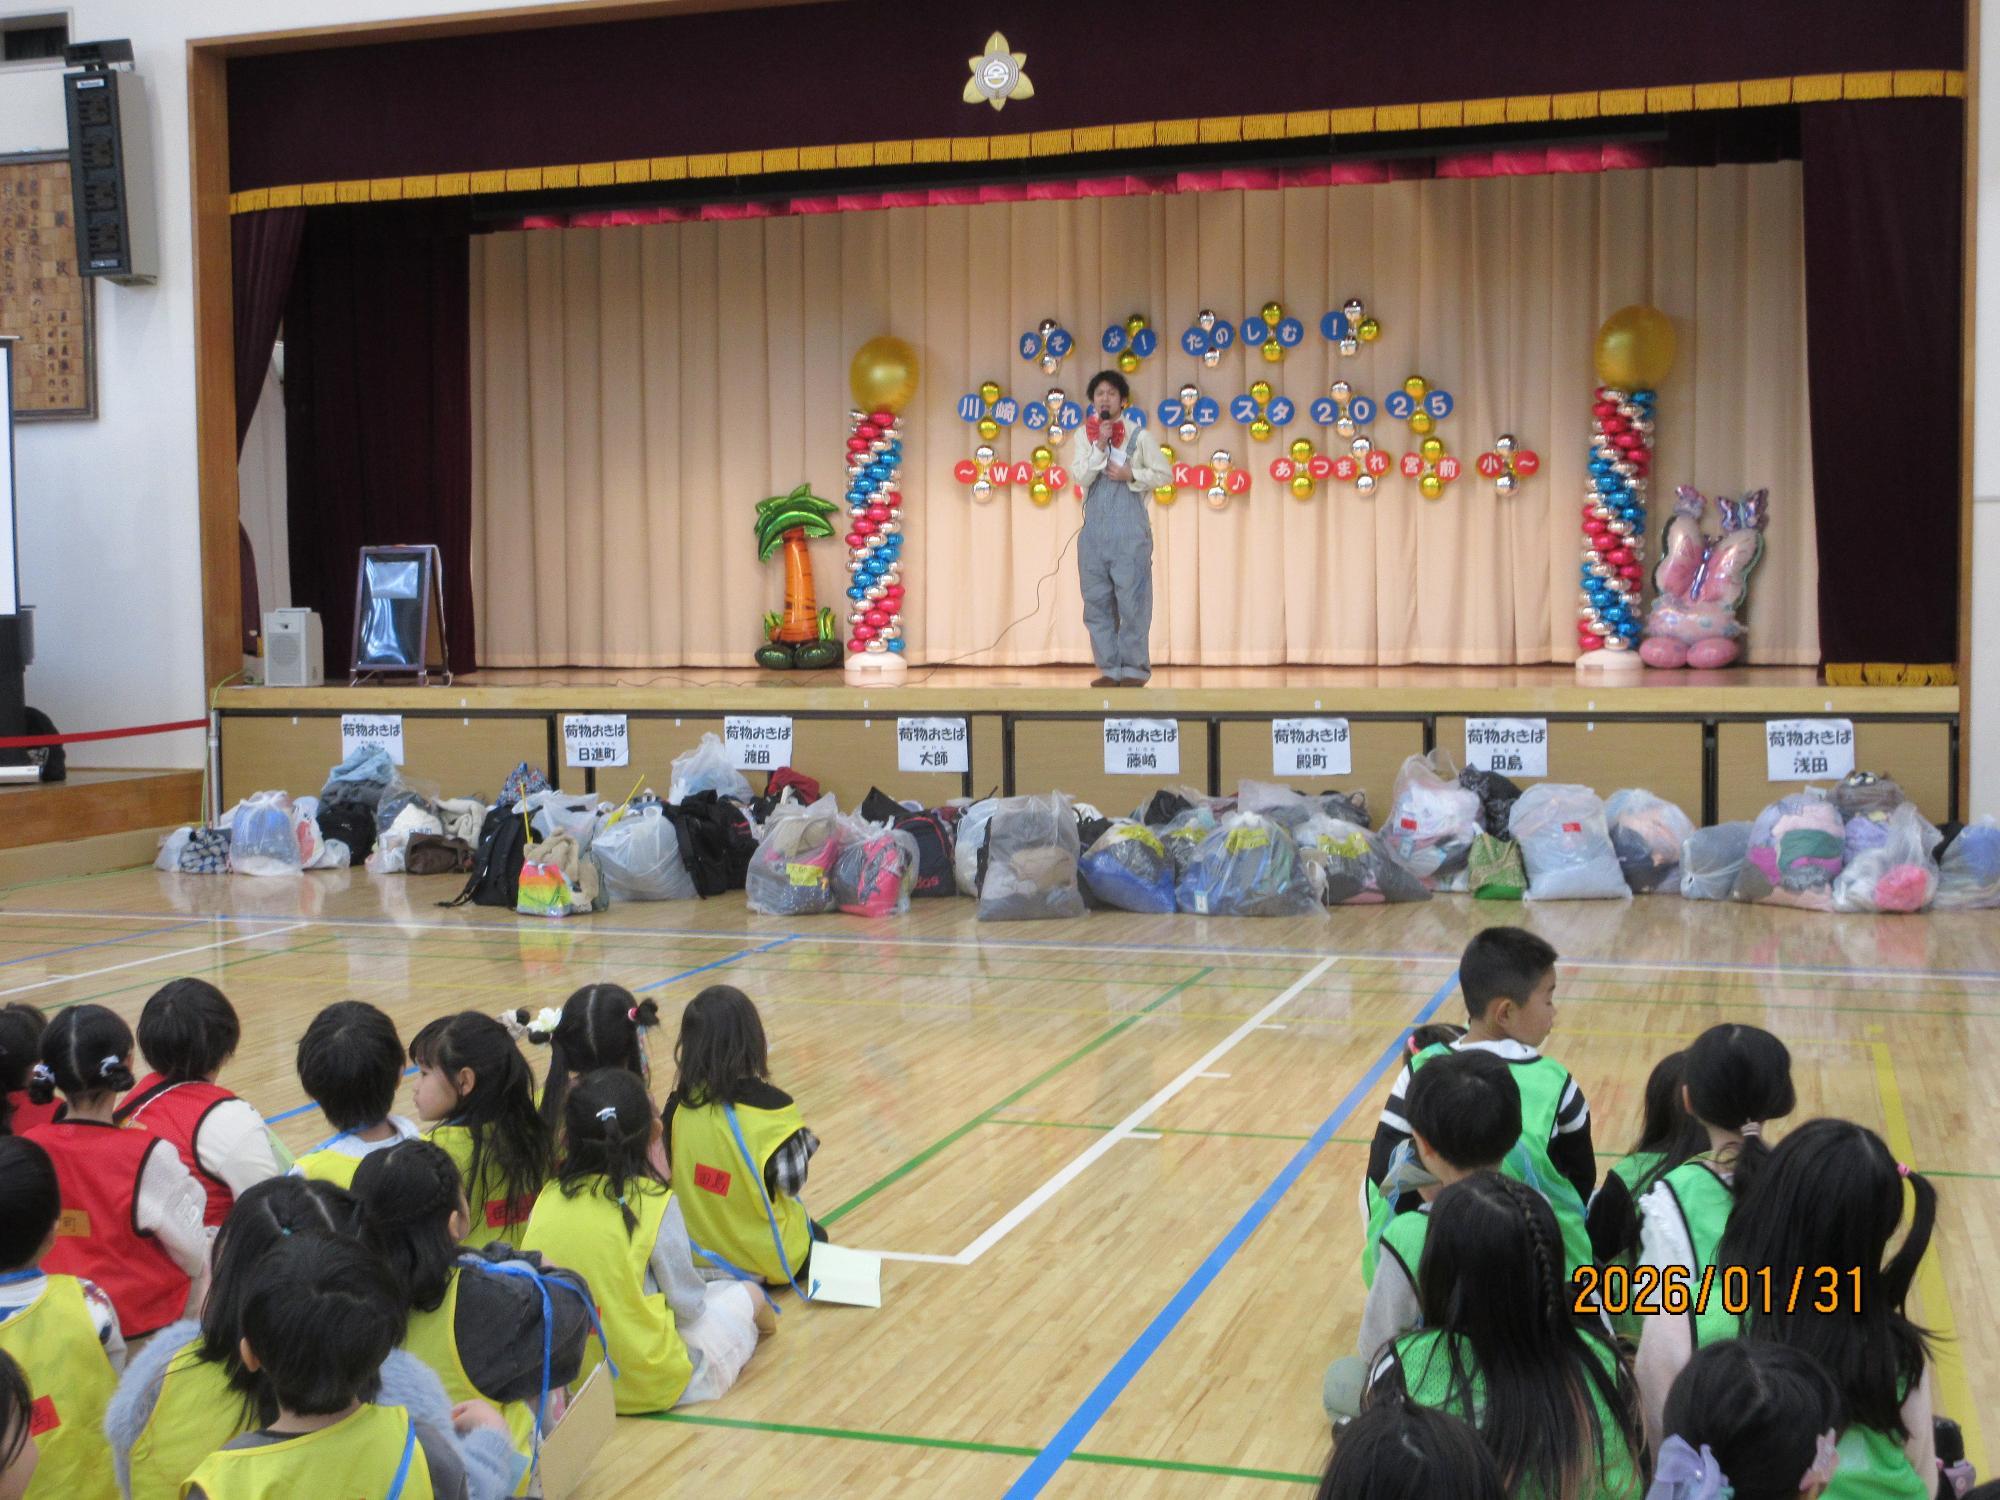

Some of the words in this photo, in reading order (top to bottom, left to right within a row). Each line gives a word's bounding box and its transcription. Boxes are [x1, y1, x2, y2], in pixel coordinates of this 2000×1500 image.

[343, 723, 401, 737] 荷物おきば
[565, 724, 626, 738] 荷物おきば
[726, 725, 791, 740] 荷物おきば
[899, 727, 965, 742] 荷物おきば
[1105, 728, 1177, 743] 荷物おきば
[1274, 729, 1348, 744] 荷物おきば
[1467, 729, 1546, 744] 荷物おきば
[1769, 730, 1852, 747] 荷物おきば
[578, 747, 617, 761] 日進町
[919, 751, 948, 766] 大師
[1126, 753, 1157, 769] 藤崎
[1296, 754, 1328, 769] 殿町
[1491, 755, 1523, 771] 田島
[1794, 757, 1828, 774] 浅田
